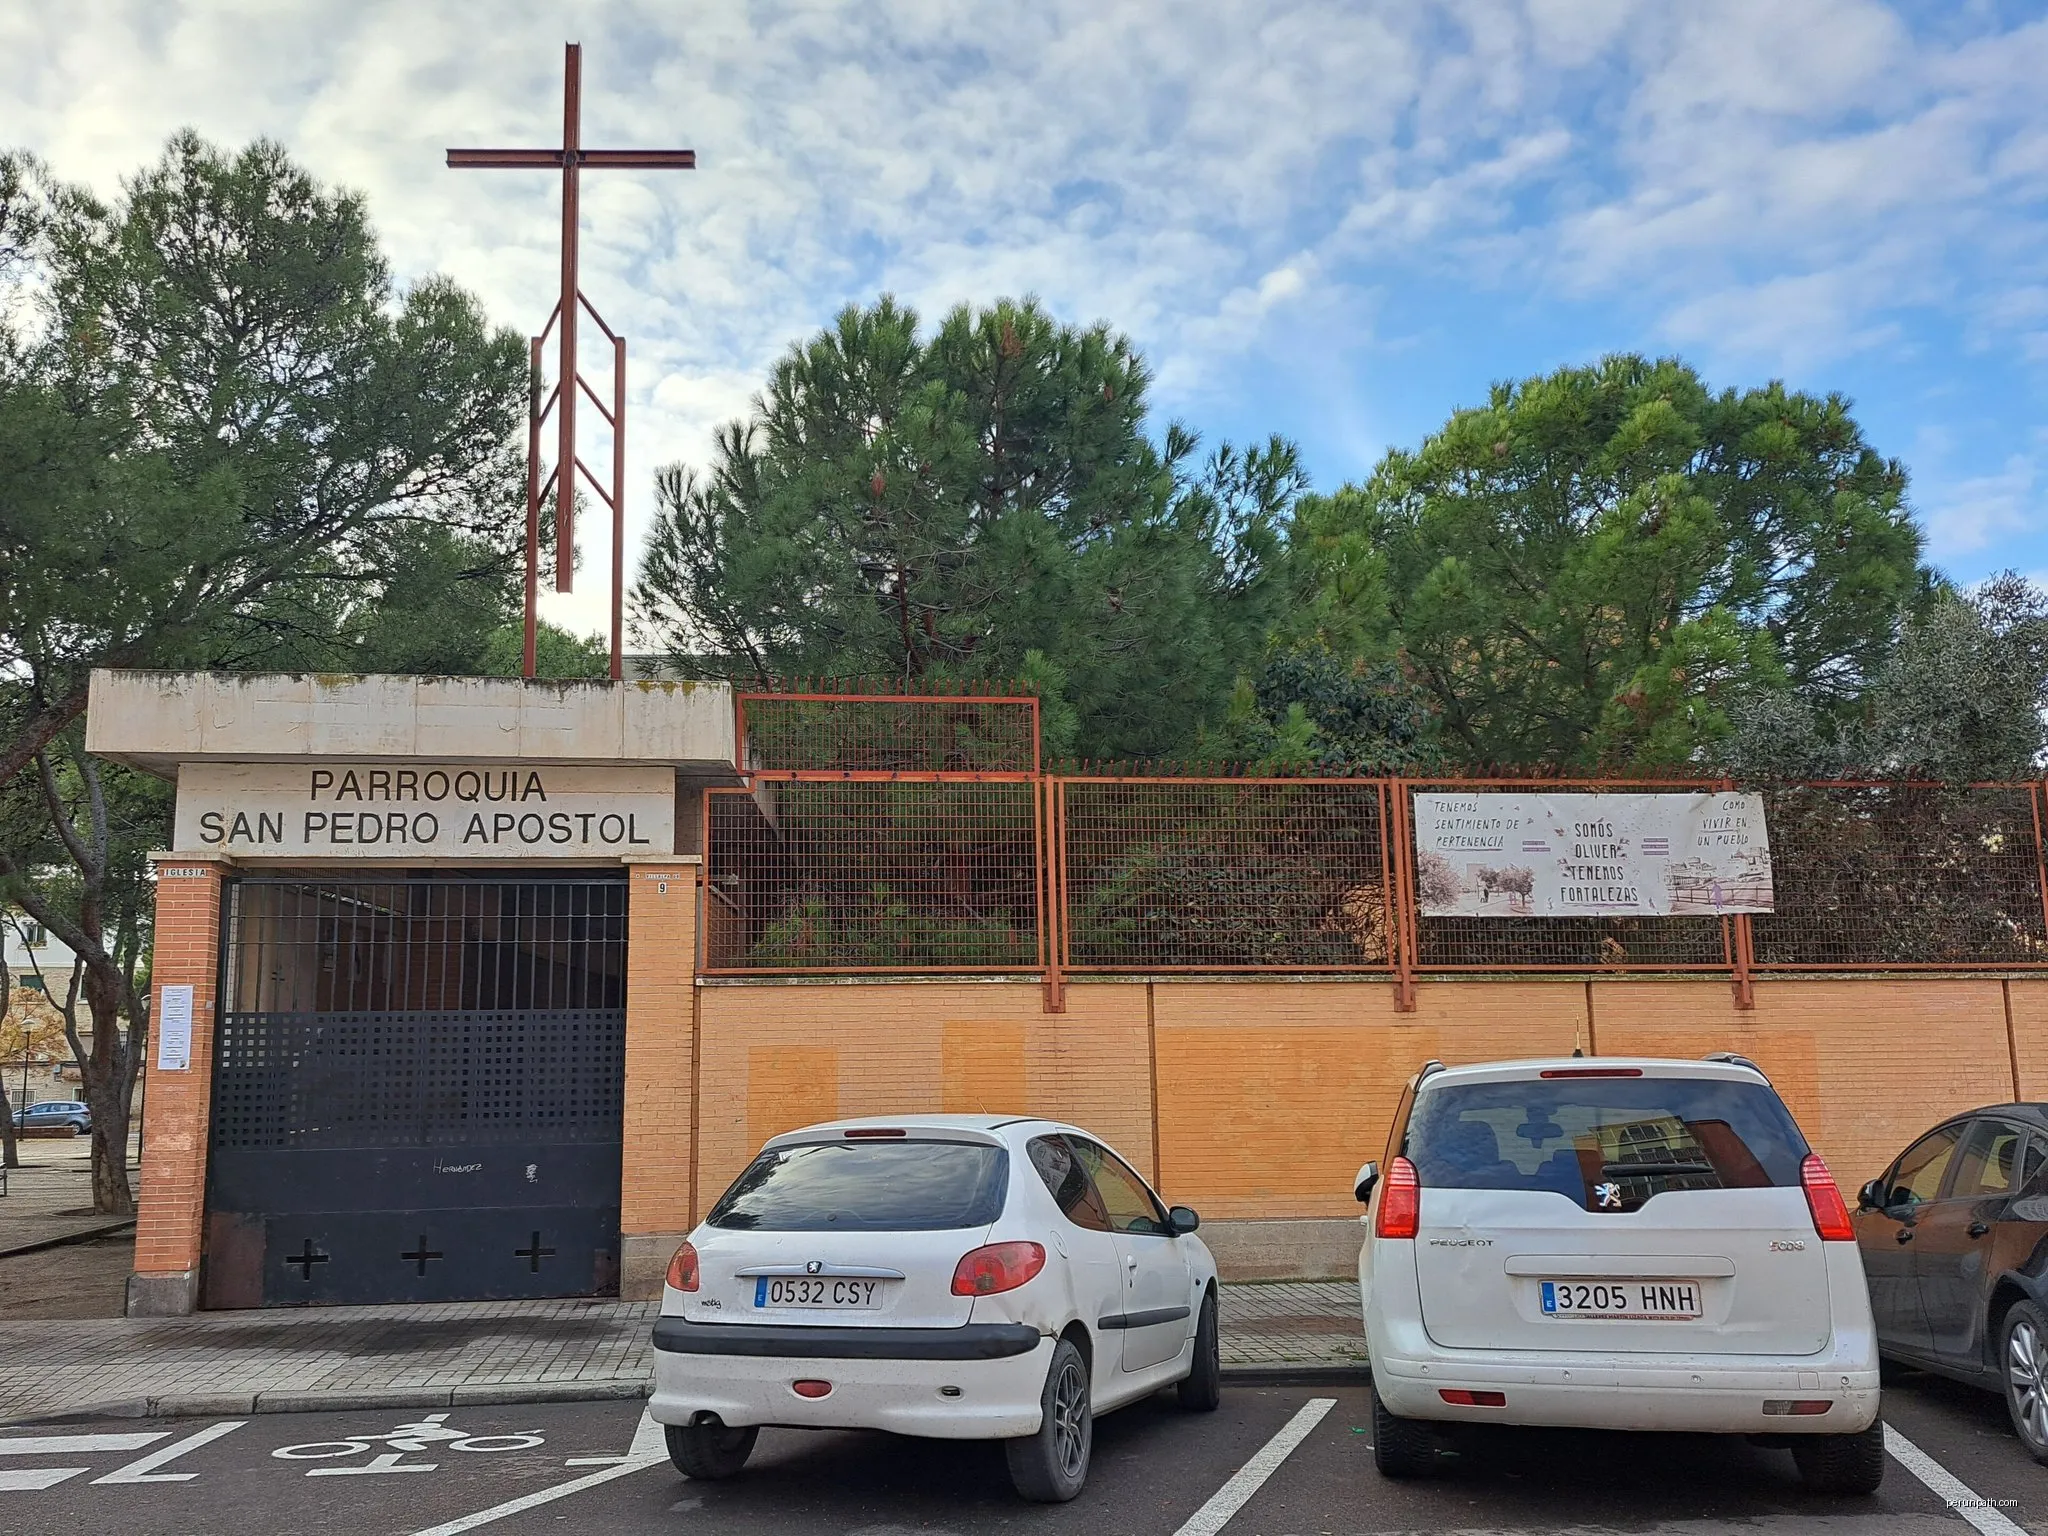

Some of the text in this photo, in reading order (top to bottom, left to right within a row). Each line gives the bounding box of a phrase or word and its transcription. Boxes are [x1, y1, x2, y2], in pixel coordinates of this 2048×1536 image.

[311, 769, 548, 803] PARROQUIA
[1434, 801, 1478, 812] TENEMOS
[1722, 800, 1745, 811] COMO
[200, 811, 650, 845] SAN PEDRO APOSTOL
[1434, 818, 1520, 830] SENTIMIENTO DE
[1703, 816, 1747, 829] VIVIR EN
[1436, 835, 1504, 848] PERTENENCIA
[1697, 834, 1749, 846] UN PUEBLO
[1575, 843, 1617, 859] OLIVER
[165, 868, 206, 876] IGLESIA
[1570, 865, 1624, 880] TENEMOS
[659, 883, 666, 893] 9
[1560, 886, 1638, 902] FORTALEZAS
[1429, 1239, 1494, 1247] PEUGEOT
[1769, 1240, 1805, 1251] 5008
[770, 1280, 824, 1304] 0532
[833, 1281, 876, 1305] CSY
[1558, 1285, 1627, 1310] 3205
[1641, 1286, 1695, 1311] HNH
